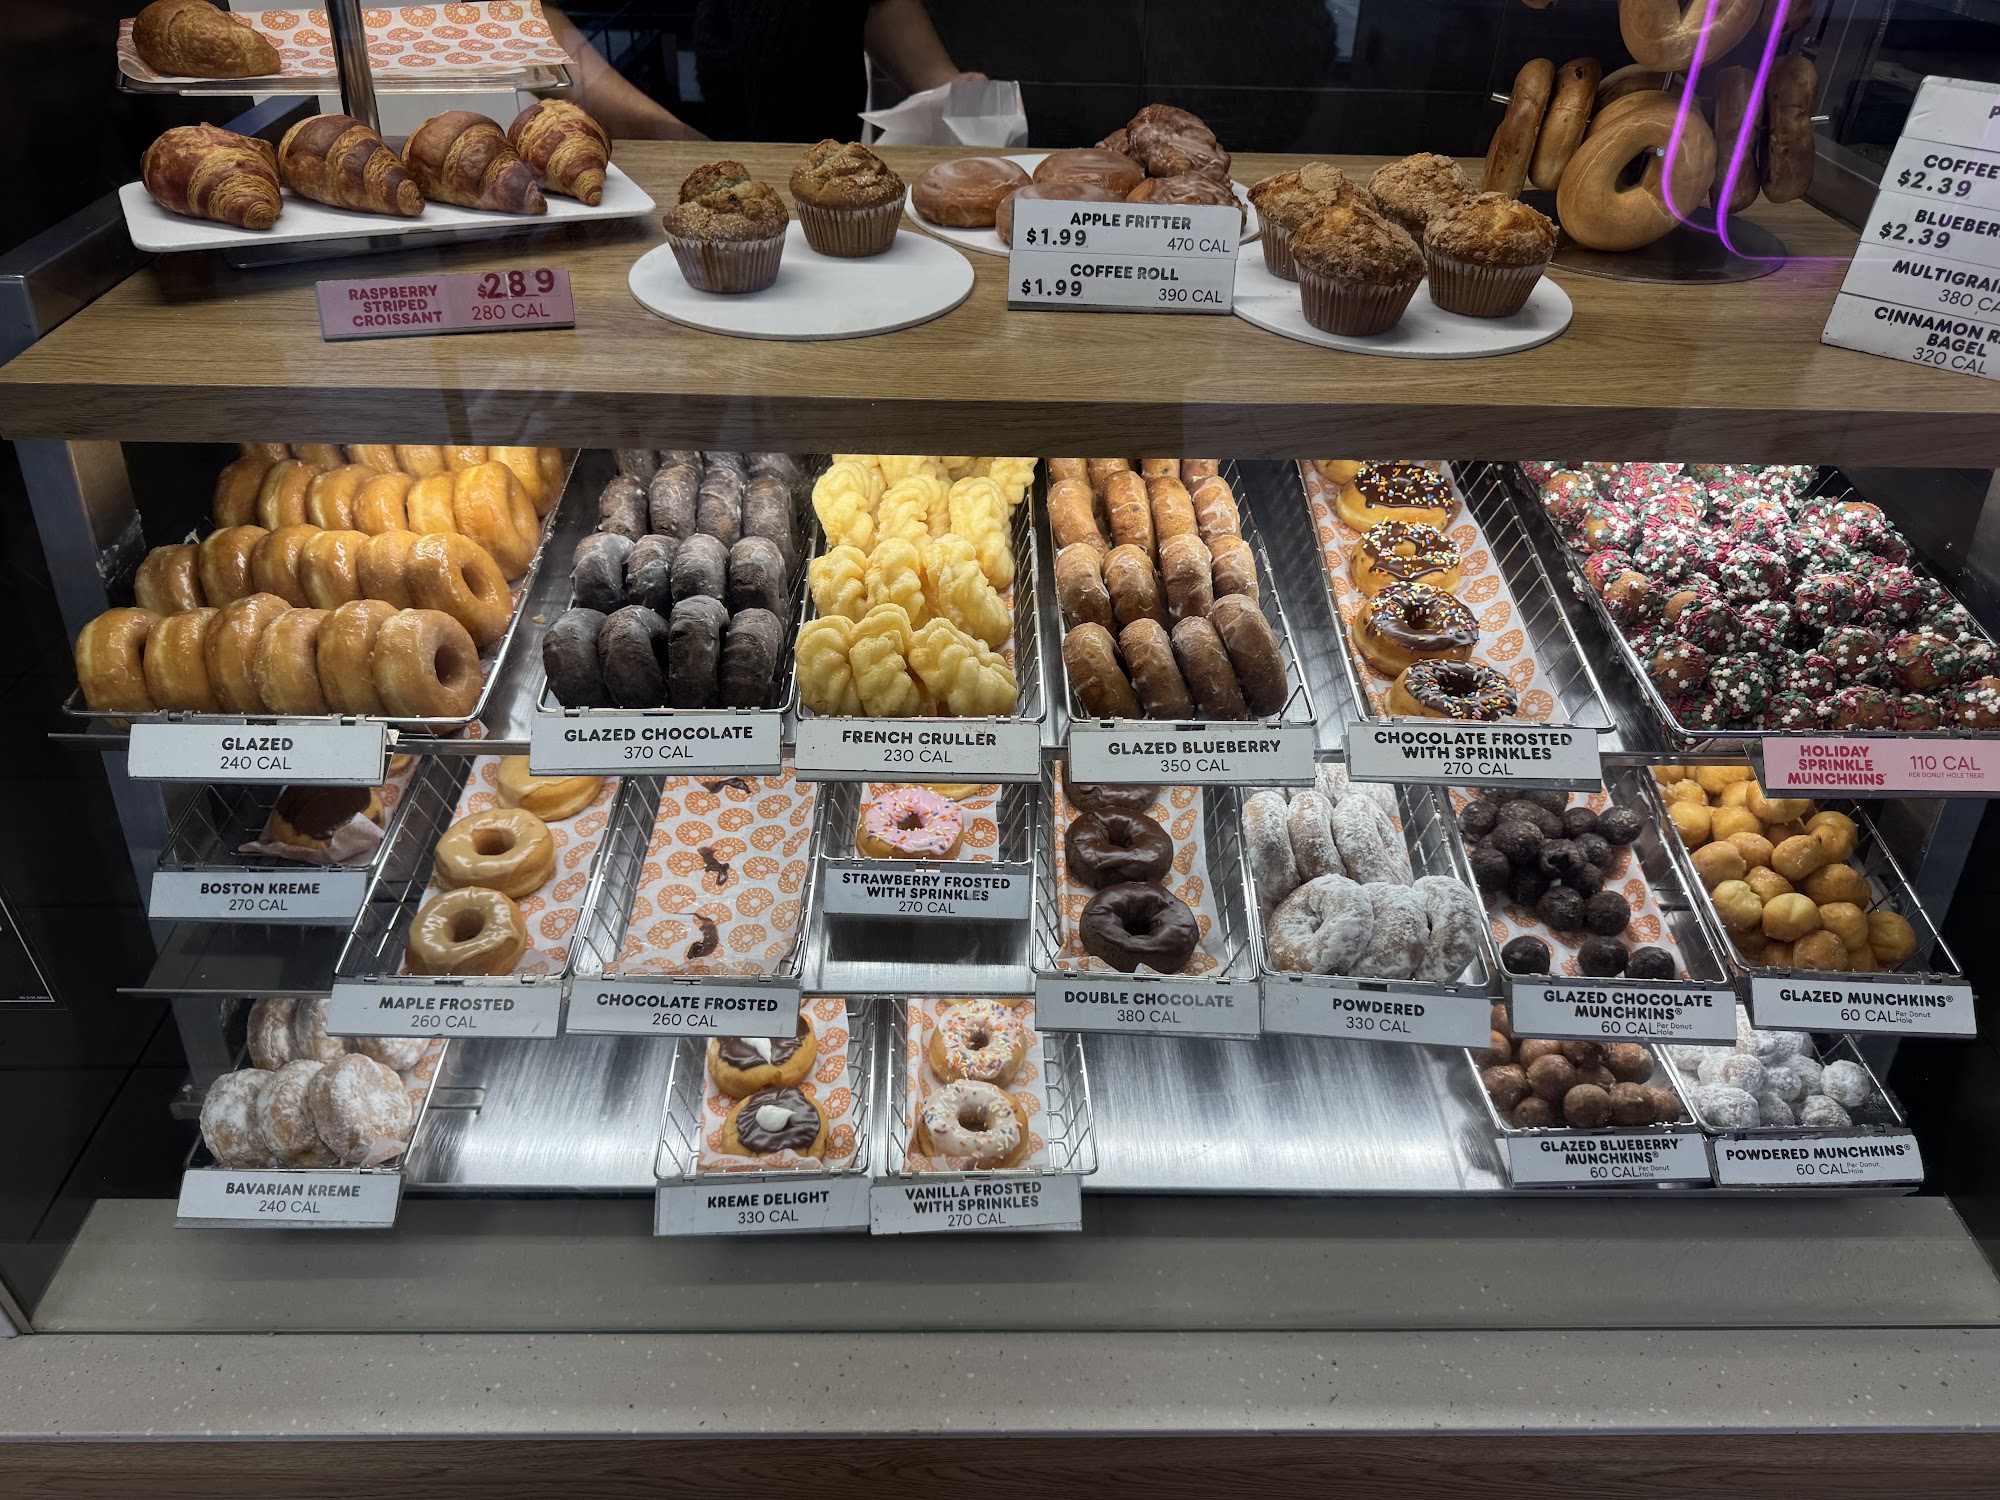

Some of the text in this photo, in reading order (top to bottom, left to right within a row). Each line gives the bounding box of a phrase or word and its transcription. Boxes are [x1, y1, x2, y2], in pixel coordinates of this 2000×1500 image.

[1923, 154, 2000, 179] COFFEE
[1897, 169, 1972, 197] $2.39
[1070, 212, 1191, 230] APPLE FRITTER
[1914, 209, 2000, 238] BLUEBER
[1026, 228, 1087, 246] $1.99
[1879, 222, 1950, 249] $2.39
[1167, 238, 1230, 253] 470 CAL
[1070, 264, 1179, 281] COFFEE ROLL
[1892, 260, 2000, 294] MULTIGRAI
[348, 285, 437, 301] RASPBERRY
[1021, 279, 1082, 297] $1.99
[1158, 288, 1222, 303] 390 CAL
[363, 299, 428, 313] STRIPED
[1939, 290, 1973, 307] 380
[352, 311, 442, 327] CROISSANT
[472, 303, 550, 320] 280 CAL
[1874, 306, 1983, 340] CINNAMON
[1926, 333, 1987, 357] BAGEL
[1913, 347, 1987, 375] 320 CAL
[564, 726, 753, 742] GLAZED CHOCOLATE
[842, 730, 996, 746] FRENCH CRULLER
[1374, 731, 1572, 746] CHOCOLATE FROSTED
[221, 737, 294, 751] GLAZED
[1108, 740, 1281, 755] GLAZED BLUEBERRY
[1800, 745, 1869, 758] HOLIDAY
[624, 745, 693, 759] 370 CAL
[884, 749, 953, 763] 230 CAL
[1401, 746, 1552, 760] WITH SPRINKLES
[220, 757, 291, 770] 240 CAL
[1160, 759, 1230, 772] 350 CAL
[1444, 763, 1513, 775] 270 CAL
[1798, 759, 1873, 771] SPRINKLE
[1910, 756, 1980, 770] 110 CAL
[200, 883, 320, 894] BOSTON KREME
[842, 873, 1010, 889] STRAWBERRY FROSTED
[867, 886, 989, 901] WITH SPRINKLES
[229, 899, 288, 910] 270 CAL
[899, 902, 955, 914] 270 CAL
[379, 997, 514, 1011] MAPLE FROSTED
[597, 994, 778, 1012] CHOCOLATE FROSTED
[1064, 991, 1234, 1008] DOUBLE CHOCOLATE
[1544, 990, 1712, 1007] GLAZED CHOCOLATE
[1780, 989, 1843, 1004] GLAZED
[1333, 998, 1424, 1016] POWDERED
[411, 1015, 477, 1028] 260 CAL
[652, 1013, 717, 1027] 260 CAL
[1117, 1010, 1181, 1023] 380 CAL
[1841, 1009, 1896, 1022] 60 CAL
[1346, 1017, 1411, 1033] 330 CAL
[1601, 1021, 1656, 1035] 60 CAL
[1540, 1138, 1679, 1152] GLAZED BLUEBERRY
[1726, 1149, 1809, 1161] POWDERED
[1590, 1167, 1639, 1178] 60 CAL
[1796, 1163, 1848, 1175] 60 CAL
[225, 1182, 361, 1197] BAVARIAN KREME
[905, 1182, 1041, 1200] VANILLA FROSTED
[259, 1200, 320, 1213] 240 CAL
[708, 1191, 829, 1208] KREME DELIGHT
[913, 1195, 1039, 1213] WITH SPRINKLES
[738, 1210, 798, 1224] 330 CAL
[948, 1213, 1006, 1227] 270 CAL
